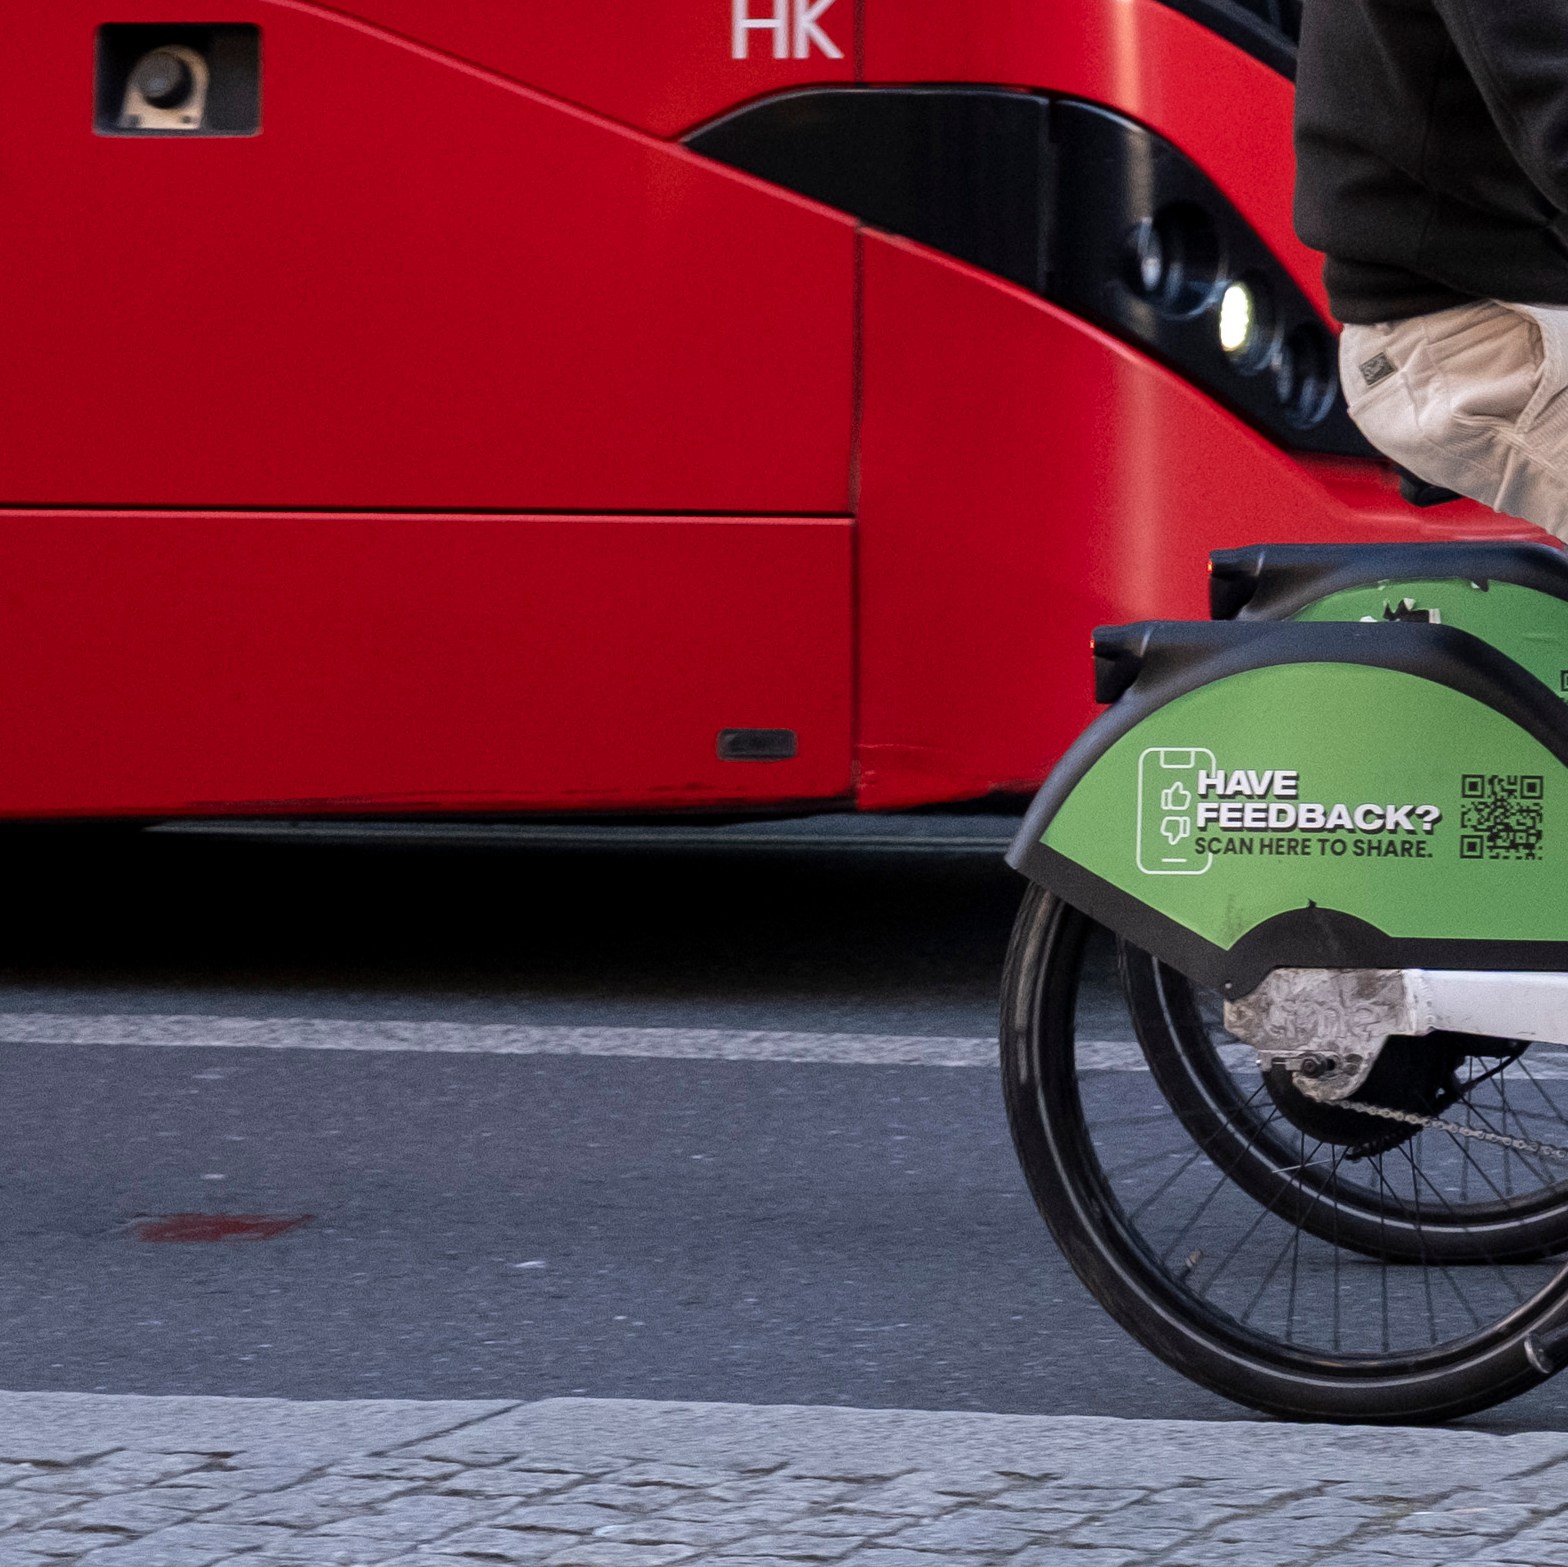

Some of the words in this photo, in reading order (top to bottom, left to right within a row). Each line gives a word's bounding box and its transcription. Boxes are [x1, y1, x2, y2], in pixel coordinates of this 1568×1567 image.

[1197, 769, 1299, 800] HAVE
[1196, 802, 1442, 834] FEEDBACK?
[1195, 837, 1254, 856] SCAN
[1259, 838, 1312, 856] HERE
[1317, 839, 1348, 856] TO
[1353, 839, 1433, 859] SHARE.
